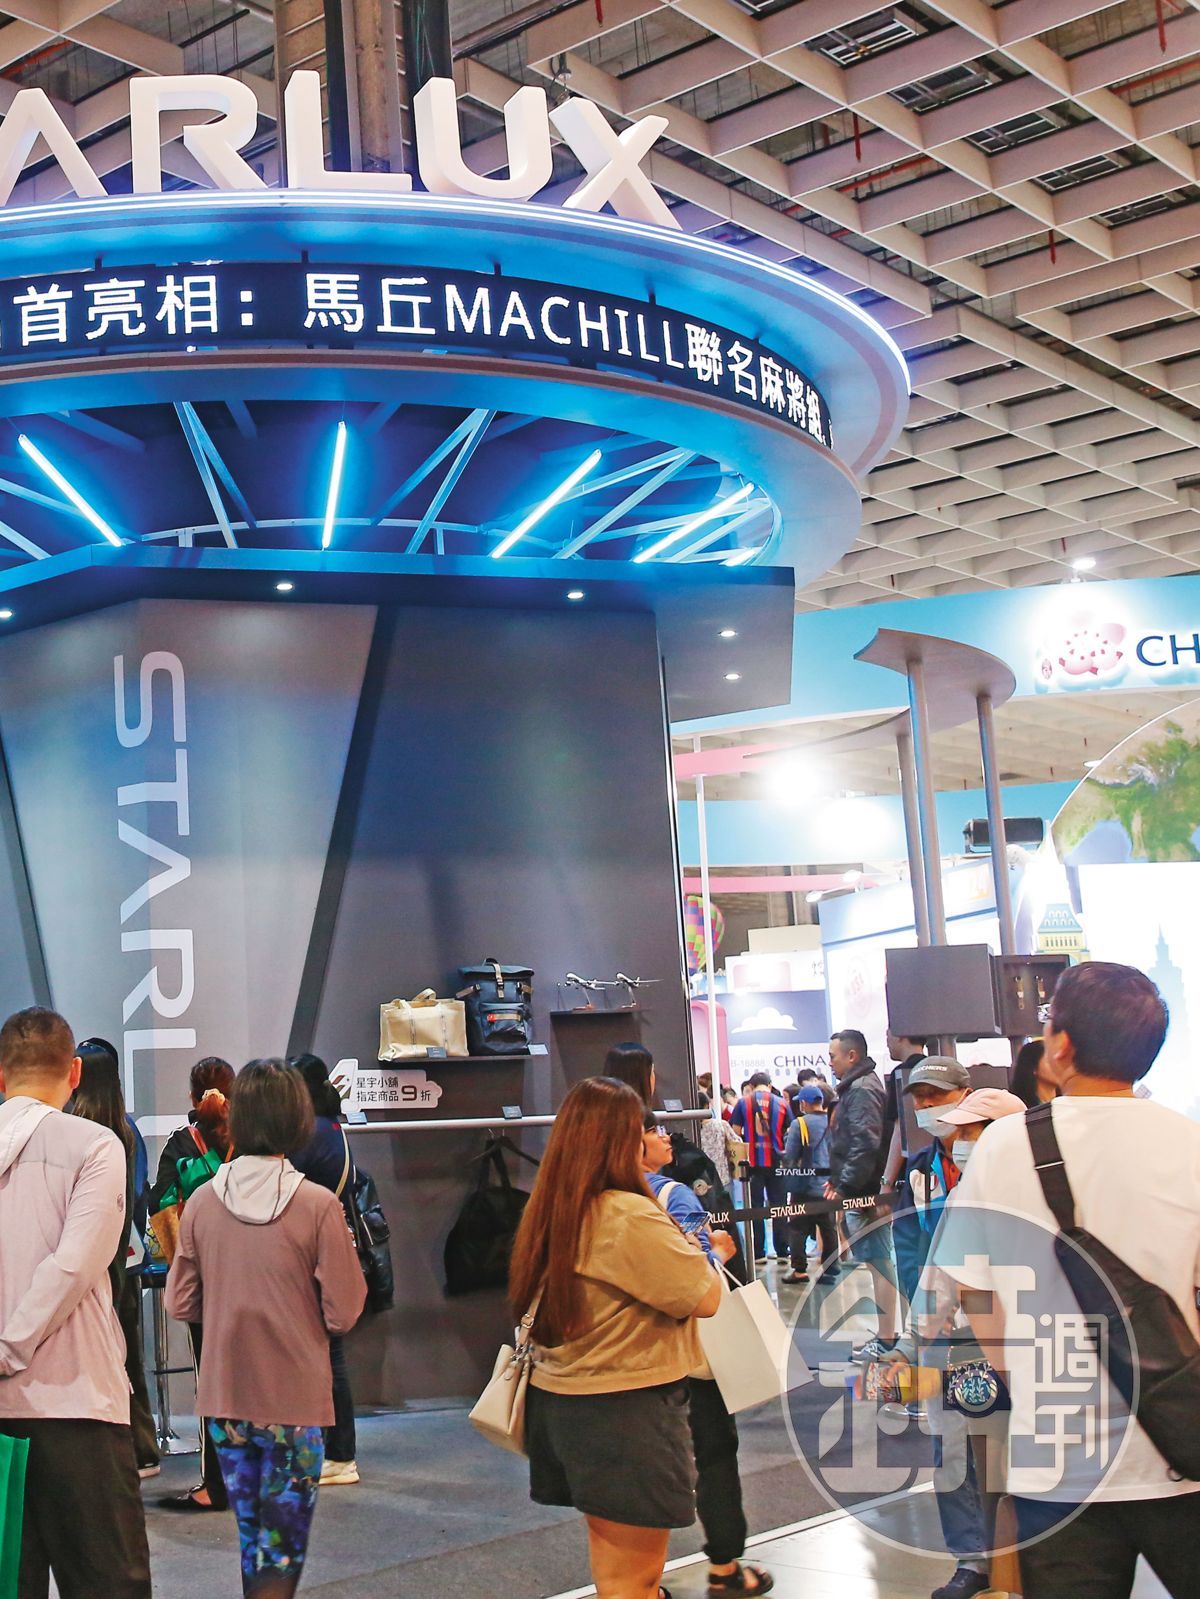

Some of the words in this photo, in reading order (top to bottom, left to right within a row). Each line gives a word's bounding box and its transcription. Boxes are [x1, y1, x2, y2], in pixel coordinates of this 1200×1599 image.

[773, 1055, 827, 1068] CHINA
[356, 1077, 399, 1088] 星宇小舖
[775, 1168, 816, 1176] STARLUX
[770, 1203, 806, 1219] STARLUX
[842, 1196, 876, 1210] STARLUX
